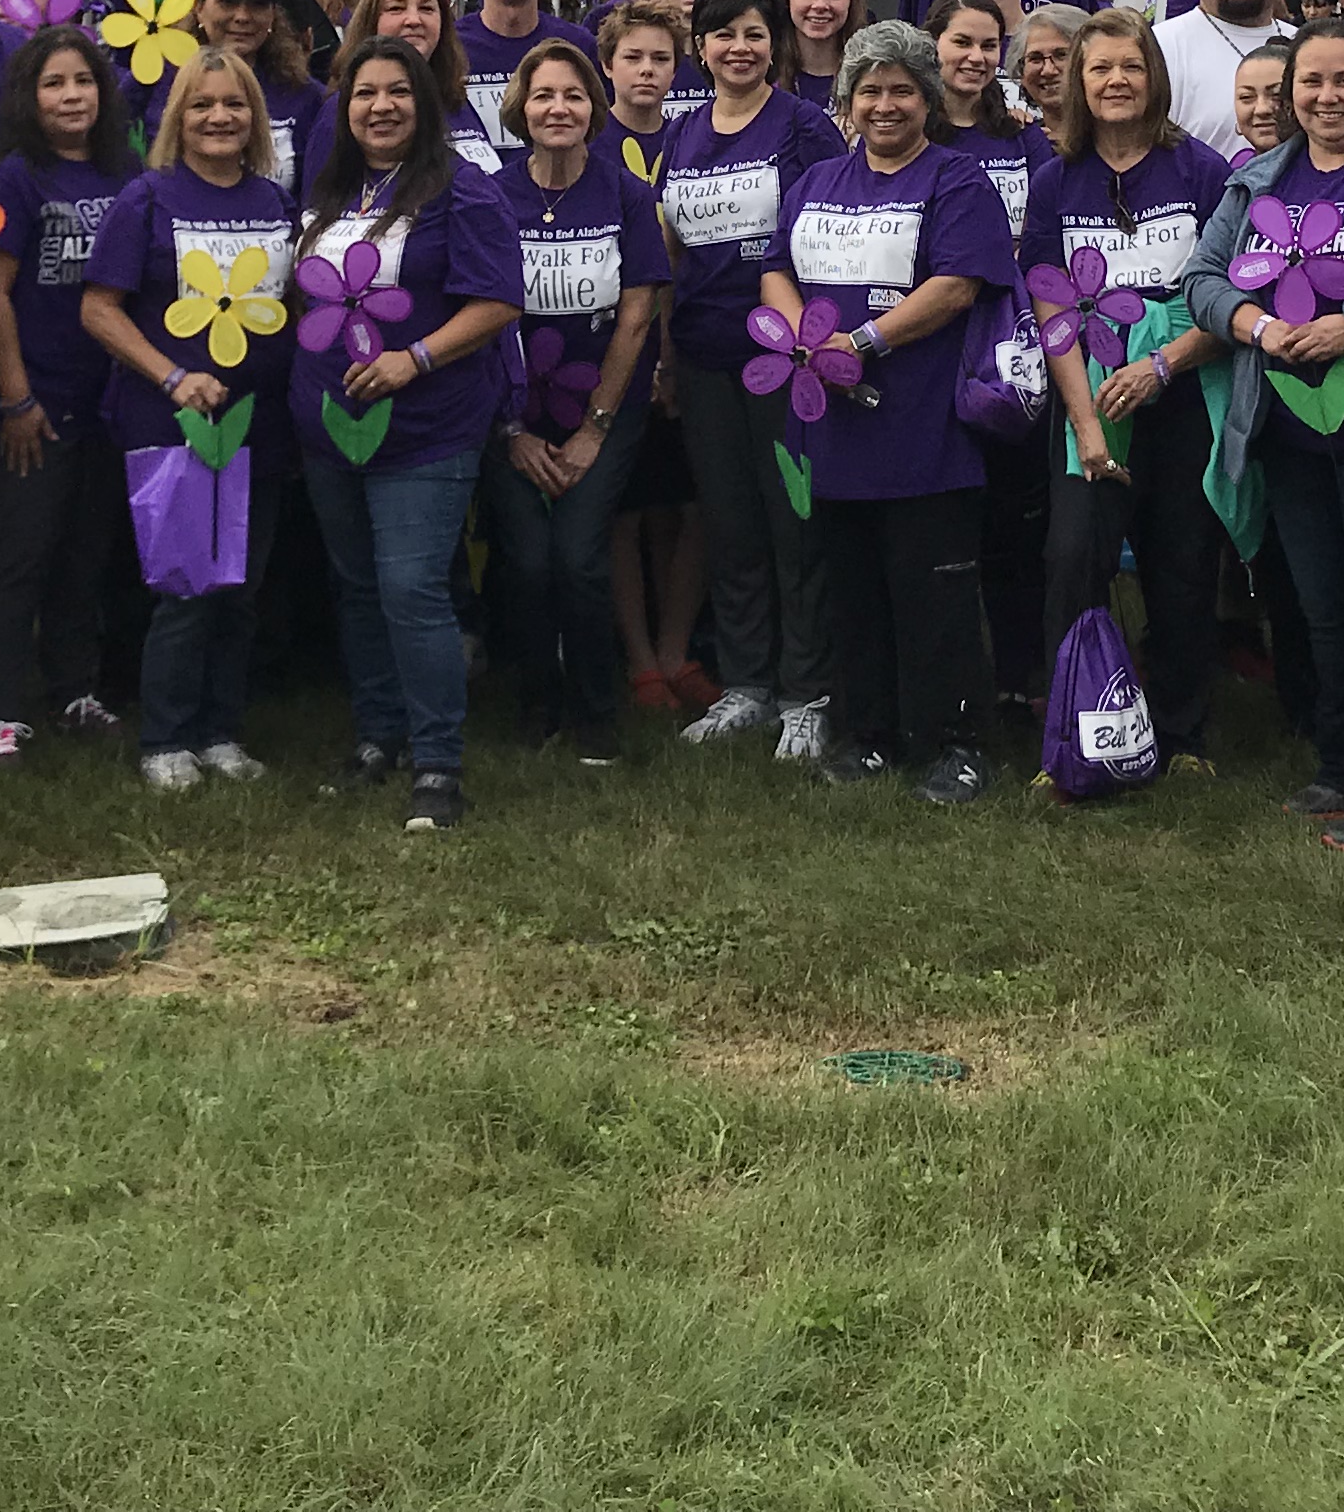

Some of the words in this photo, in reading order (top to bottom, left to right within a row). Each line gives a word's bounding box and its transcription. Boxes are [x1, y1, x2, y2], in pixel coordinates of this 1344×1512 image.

[482, 72, 506, 82] Walk
[677, 90, 687, 99] to
[688, 88, 706, 99] End
[677, 181, 725, 201] Walk
[729, 174, 763, 194] For
[995, 176, 1026, 194] For
[675, 202, 692, 226] A
[1077, 215, 1104, 226] Walk
[1140, 201, 1198, 221] Alzheimer's
[542, 230, 554, 240] to
[555, 228, 574, 240] End
[800, 216, 812, 233] I
[817, 217, 865, 236] Walk
[867, 217, 904, 235] For
[1083, 234, 1139, 253] Walk
[1144, 223, 1181, 246] For
[521, 247, 573, 268] Walk
[1113, 266, 1163, 289] cure
[523, 268, 596, 310] Millie
[1093, 726, 1127, 749] Bill
